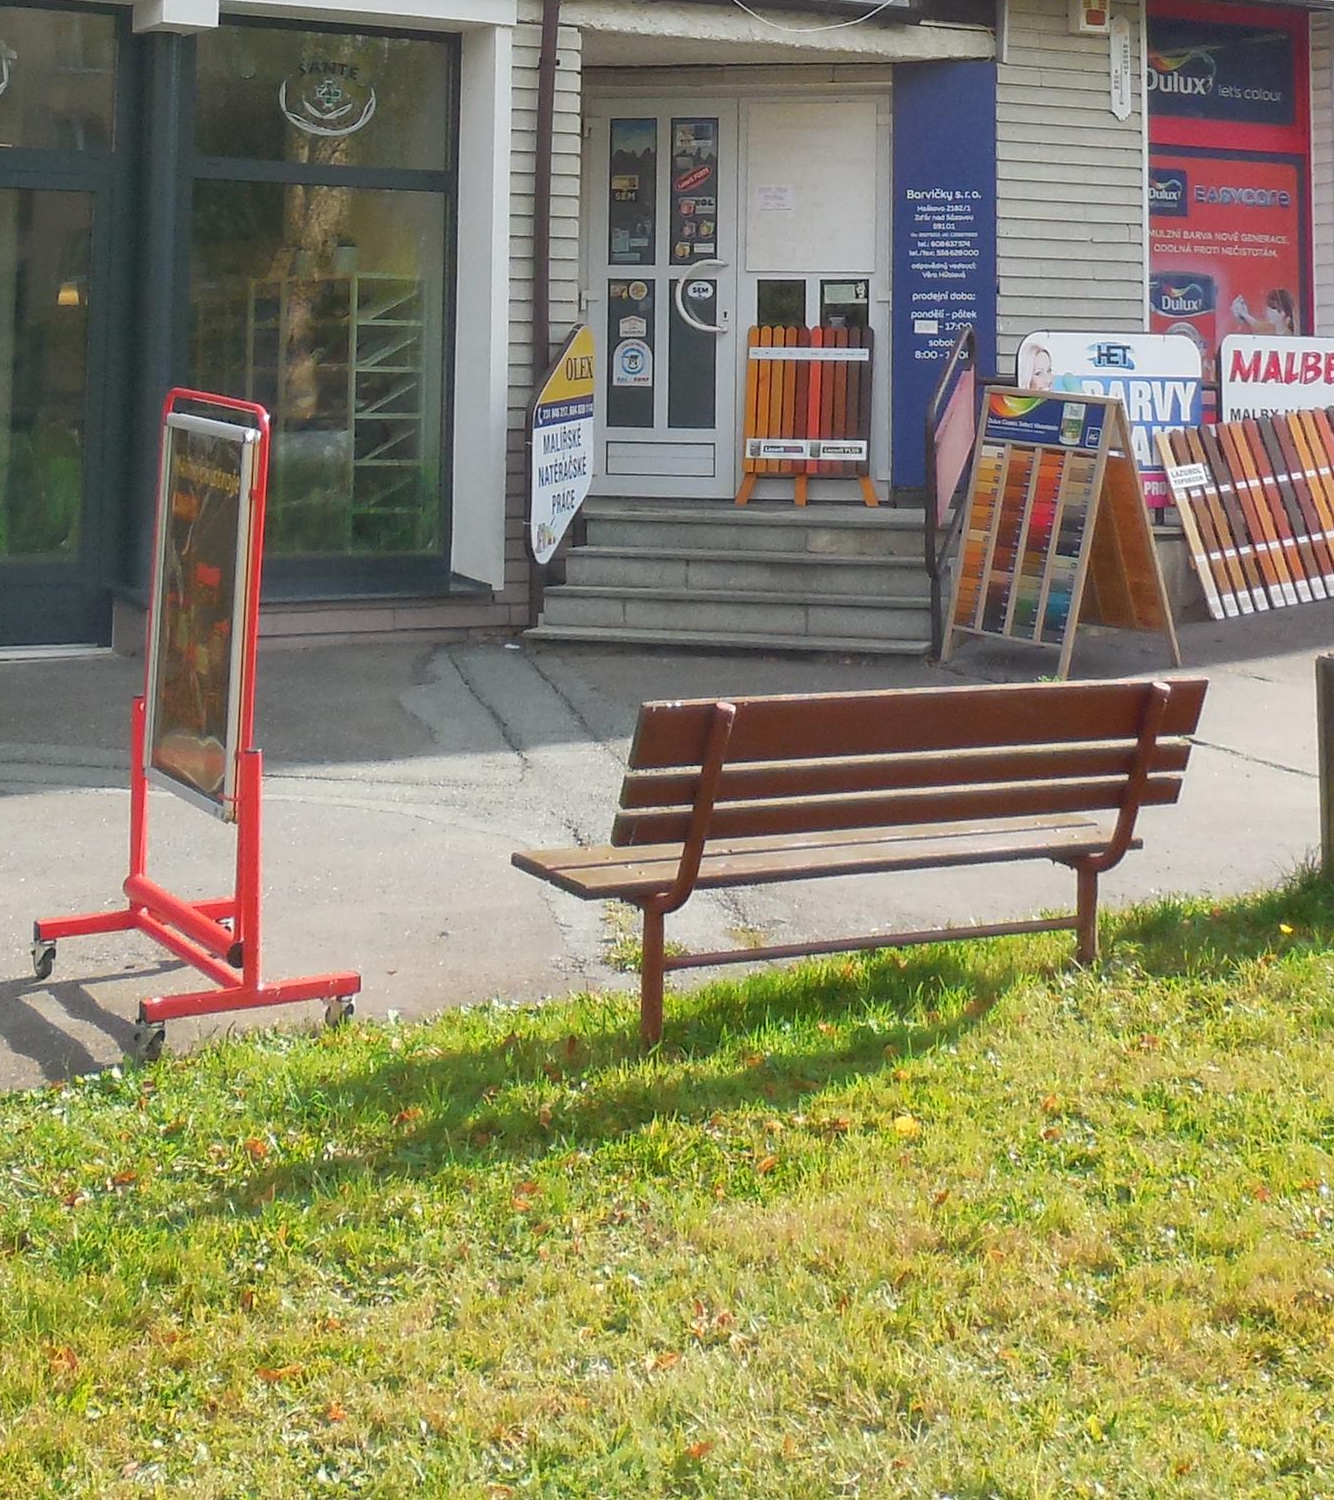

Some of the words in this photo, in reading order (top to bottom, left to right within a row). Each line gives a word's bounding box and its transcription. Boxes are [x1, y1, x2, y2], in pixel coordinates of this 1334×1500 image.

[1146, 66, 1207, 96] Dulux
[1243, 87, 1283, 102] colour
[907, 188, 953, 201] Barvičky
[1148, 186, 1178, 201] Dulux
[1149, 227, 1182, 240] MULZNÍ
[1182, 230, 1213, 242] BARVA
[1214, 231, 1239, 243] NOVÉ
[1153, 243, 1192, 254] ODOLNÁ
[1193, 244, 1220, 256] PROTI
[691, 286, 709, 295] SEM
[912, 291, 948, 302] prodejní
[949, 291, 977, 300] doba:
[1161, 295, 1198, 312] Dulux
[910, 309, 945, 320] pondělí
[951, 309, 977, 320] pátek
[914, 350, 938, 360] 8:00
[1097, 344, 1132, 366] HET
[543, 426, 582, 456] MALÍŘSKÉ
[552, 488, 576, 516] PRÁCE
